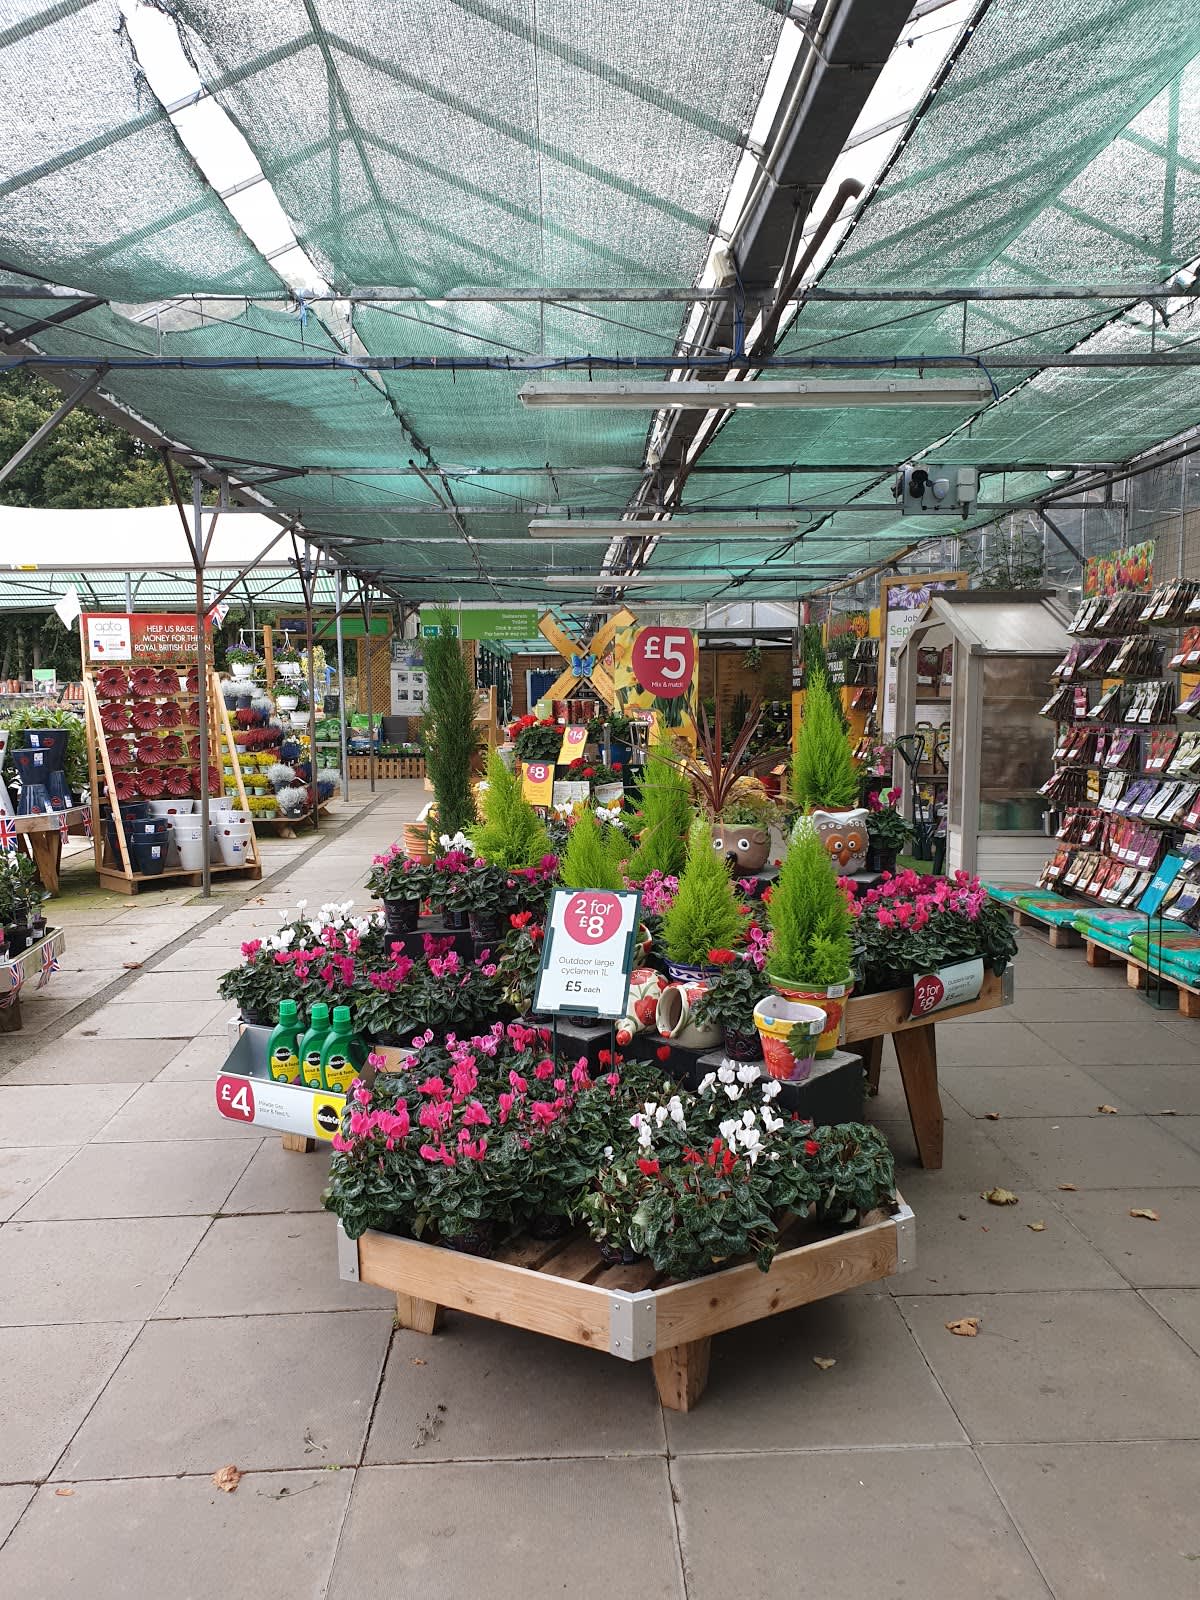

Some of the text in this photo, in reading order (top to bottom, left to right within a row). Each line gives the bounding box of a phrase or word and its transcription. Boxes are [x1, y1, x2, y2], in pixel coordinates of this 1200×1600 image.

[95, 620, 122, 633] apta
[146, 625, 195, 633] HELP US RAISE
[142, 634, 170, 642] MONEY
[171, 634, 185, 642] FOR
[134, 643, 156, 651] ROYAL
[158, 643, 183, 651] BRITISH
[185, 643, 211, 651] LEGN
[643, 635, 686, 680] £5
[529, 766, 545, 779] £8
[574, 899, 614, 915] 2 for
[579, 916, 605, 938] £8
[558, 956, 615, 968] Outdoor large
[561, 967, 599, 976] cyclamen
[565, 980, 582, 992] £5
[918, 987, 925, 999] 2
[926, 984, 940, 997] for
[920, 996, 935, 1011] £8
[221, 1084, 251, 1117] £4
